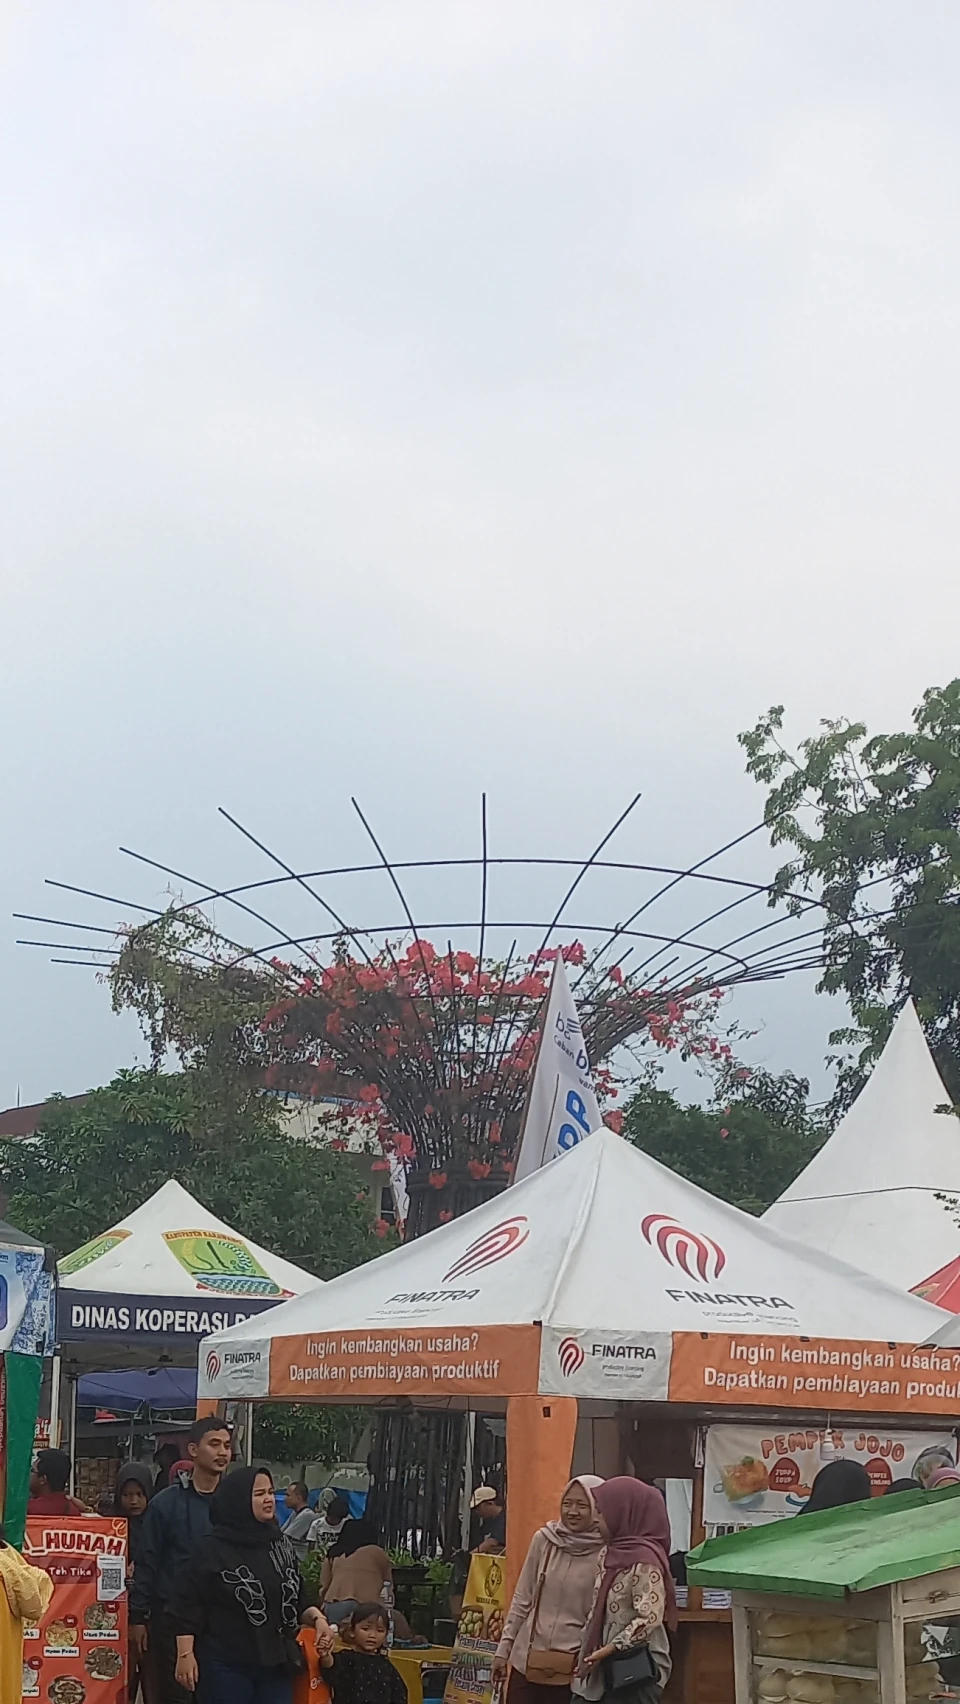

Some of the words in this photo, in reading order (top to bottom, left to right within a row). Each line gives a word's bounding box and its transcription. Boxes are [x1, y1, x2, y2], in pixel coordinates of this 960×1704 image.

[384, 1289, 481, 1305] FINATRA
[665, 1288, 795, 1310] FINATRA
[71, 1305, 130, 1330] DINAS
[136, 1308, 230, 1333] KOPERASI
[224, 1351, 261, 1364] FINATRA
[306, 1337, 337, 1358] Ingin
[341, 1333, 423, 1357] kembangkan
[427, 1332, 479, 1352] usaha?
[591, 1344, 657, 1360] FINATRA
[729, 1340, 775, 1365] Ingin
[781, 1344, 895, 1372] kembangkan
[900, 1350, 960, 1373] usaha?
[289, 1363, 346, 1385] Dapatkan
[350, 1361, 428, 1384] pembiayaan
[432, 1358, 500, 1381] produktif
[704, 1367, 788, 1391] Dapatkan
[793, 1374, 900, 1398] pembiayaan
[760, 1429, 846, 1459] PEMPK
[854, 1433, 906, 1462] JOJO
